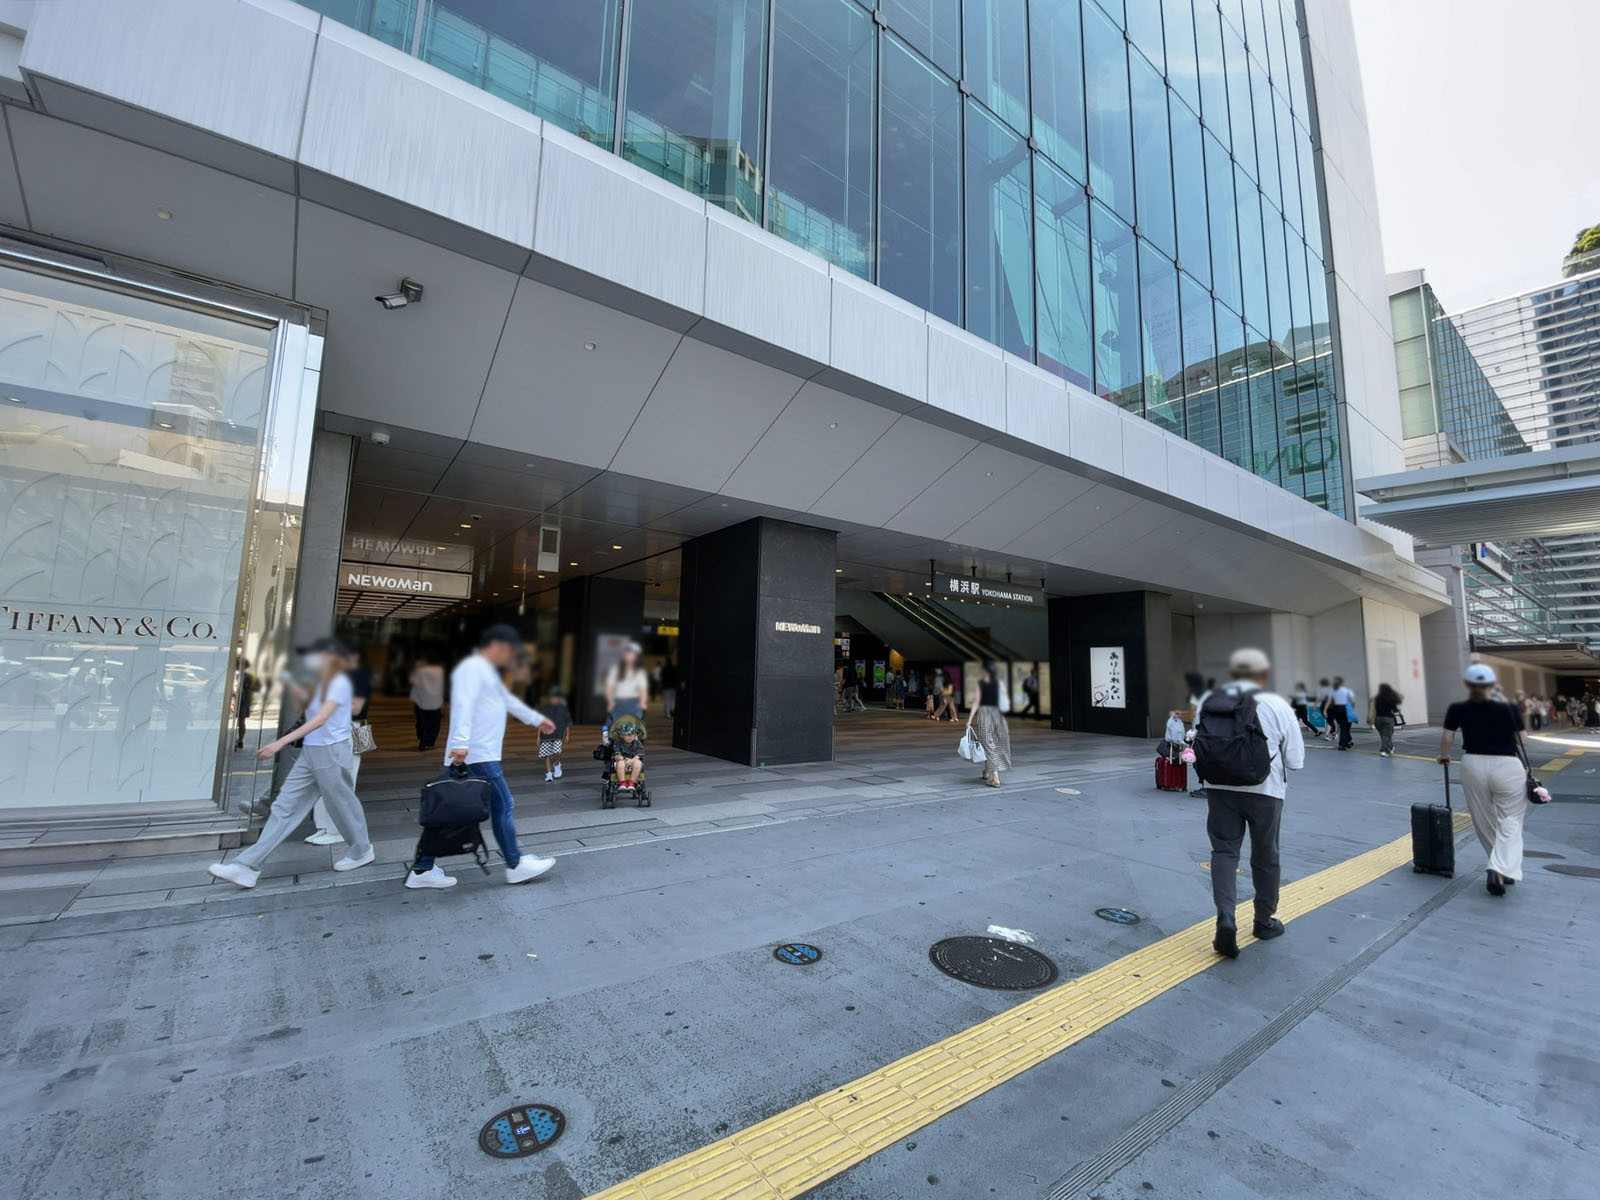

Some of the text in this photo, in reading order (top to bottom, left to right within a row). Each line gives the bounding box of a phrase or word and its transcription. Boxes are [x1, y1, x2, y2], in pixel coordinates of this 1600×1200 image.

[348, 573, 433, 592] NEWoMan
[949, 578, 980, 595] 横浜駅
[981, 588, 1034, 603] YOKOHAMA STATION
